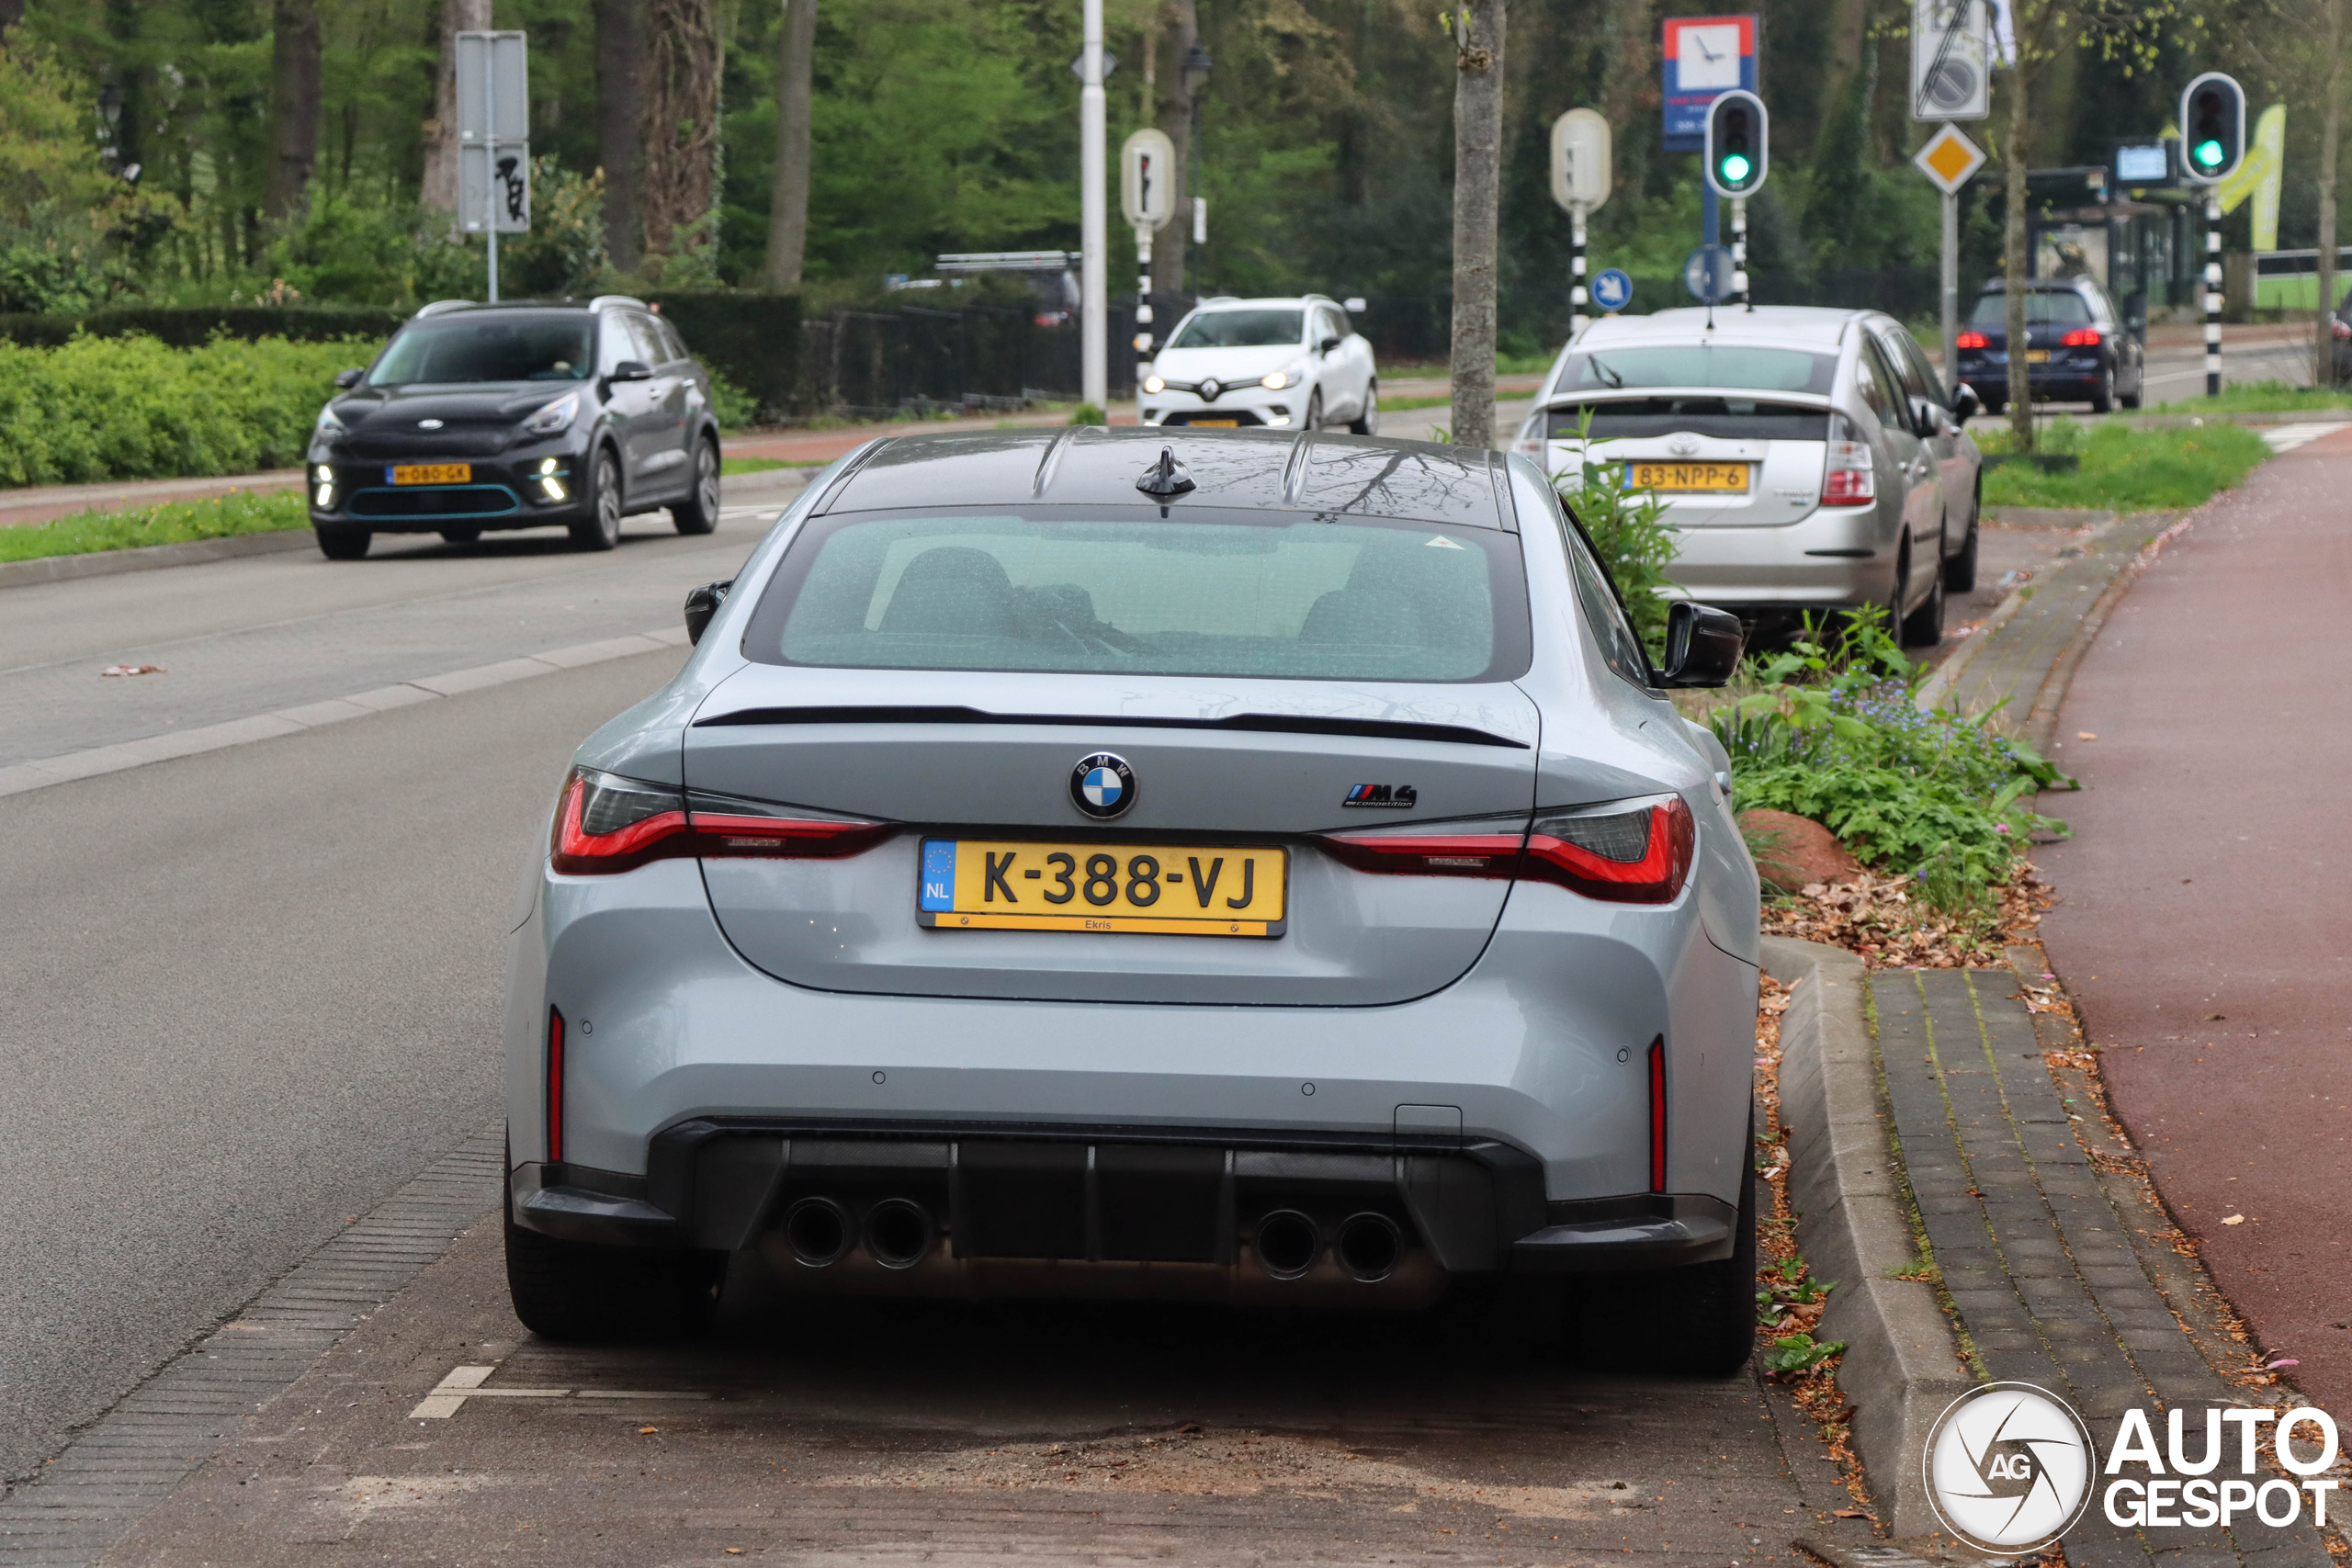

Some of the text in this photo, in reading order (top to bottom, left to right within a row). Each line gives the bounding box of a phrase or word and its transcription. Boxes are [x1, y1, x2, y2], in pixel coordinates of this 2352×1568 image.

[1640, 467, 1740, 486] 83-NPP-6
[1077, 756, 1130, 778] BMW
[984, 852, 1254, 909] K-388-VJ
[926, 883, 949, 899] NL
[1085, 919, 1112, 930] Ekris
